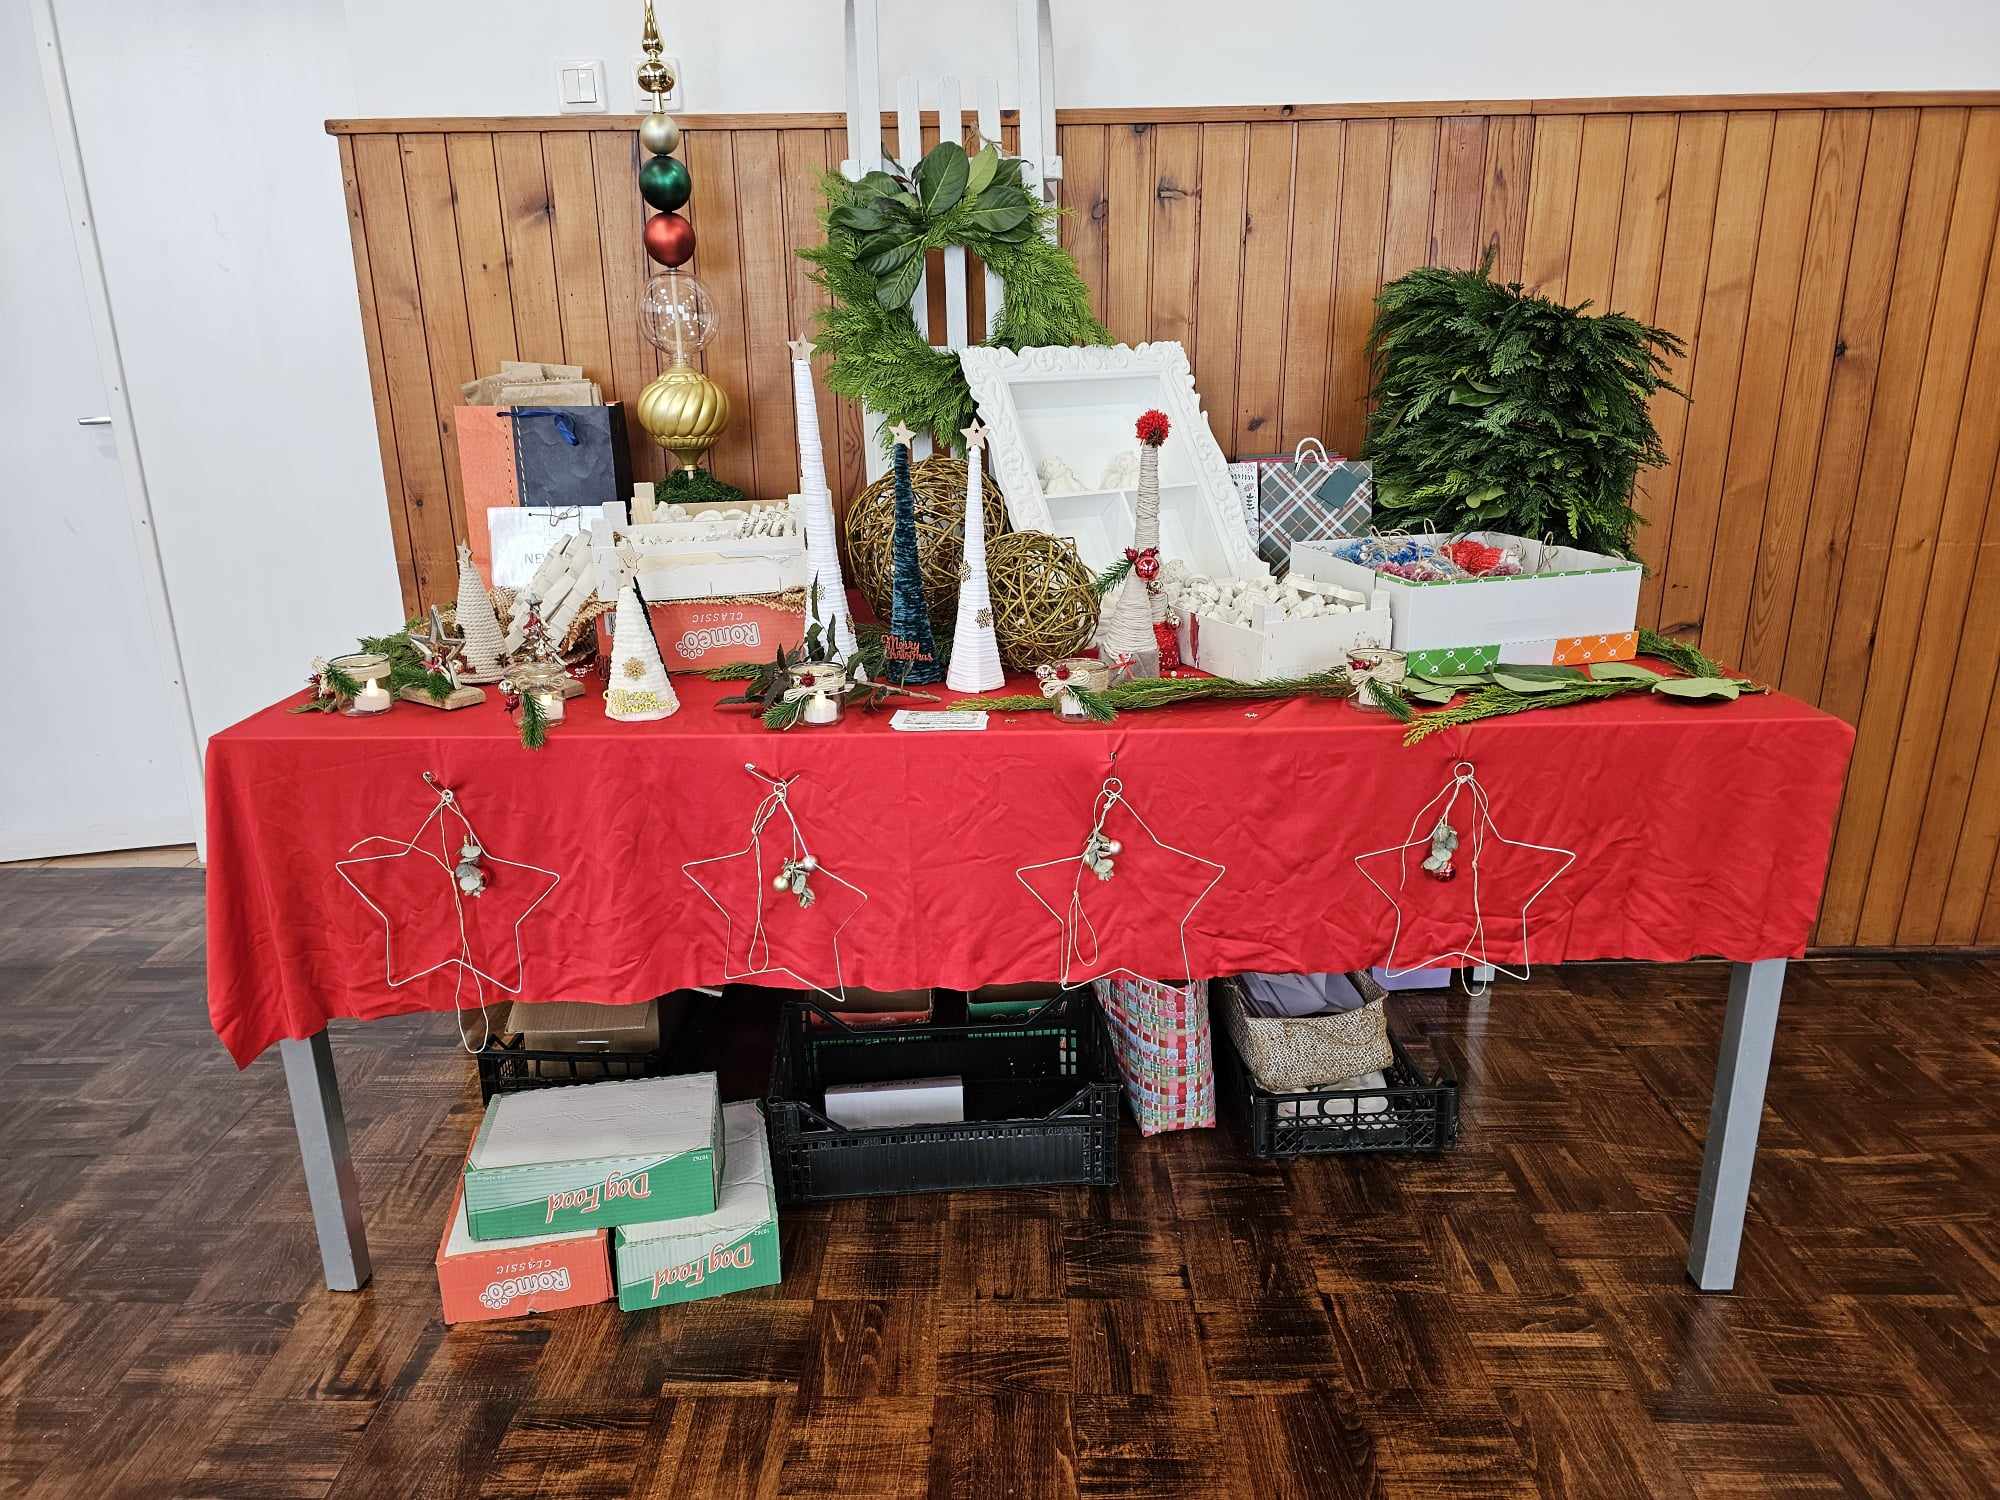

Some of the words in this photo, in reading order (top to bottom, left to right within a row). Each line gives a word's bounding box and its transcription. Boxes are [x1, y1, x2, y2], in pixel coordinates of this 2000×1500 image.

[691, 611, 743, 623] CLASSIC
[682, 621, 761, 651] Romeo
[604, 1169, 651, 1200] Dog
[545, 1184, 600, 1224] Food
[495, 1258, 552, 1274] CLASSIC
[708, 1242, 755, 1274] Dog
[485, 1267, 571, 1301] Romeo
[651, 1258, 705, 1300] Food
